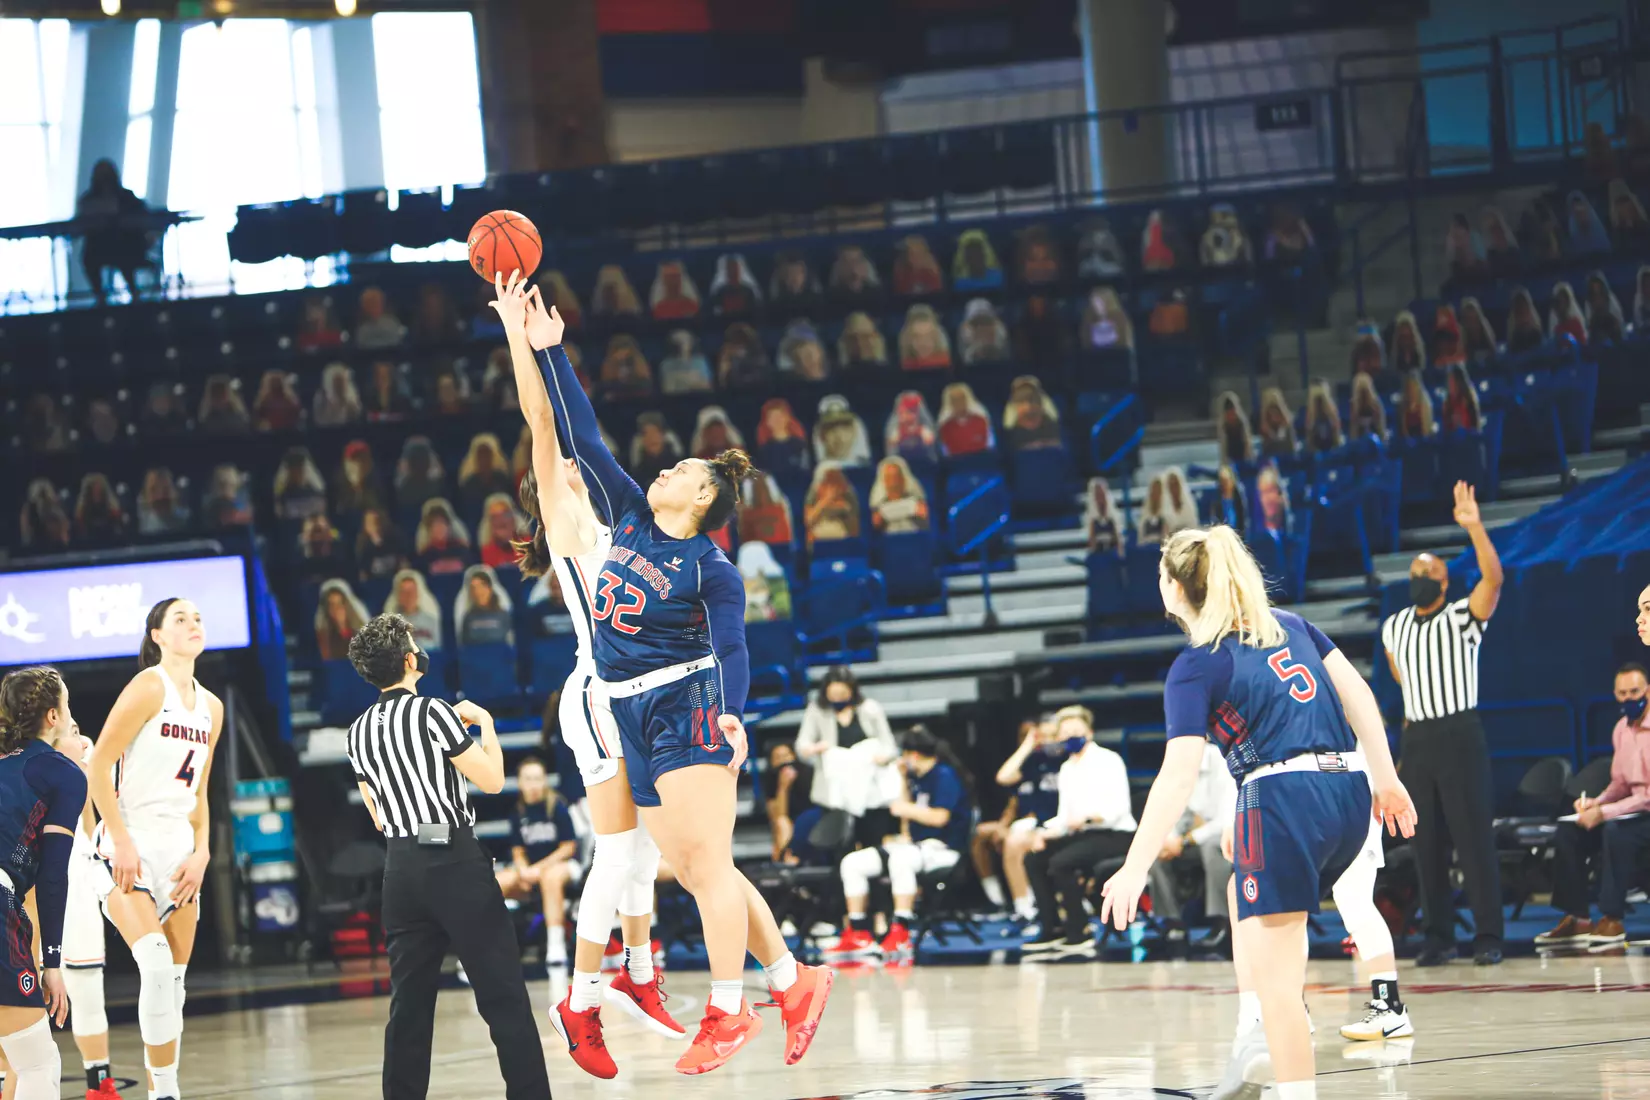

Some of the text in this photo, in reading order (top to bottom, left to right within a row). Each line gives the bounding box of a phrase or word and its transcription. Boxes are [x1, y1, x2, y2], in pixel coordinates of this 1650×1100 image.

[592, 570, 647, 635] 32
[1267, 647, 1317, 703] 5
[175, 749, 195, 788] 4
